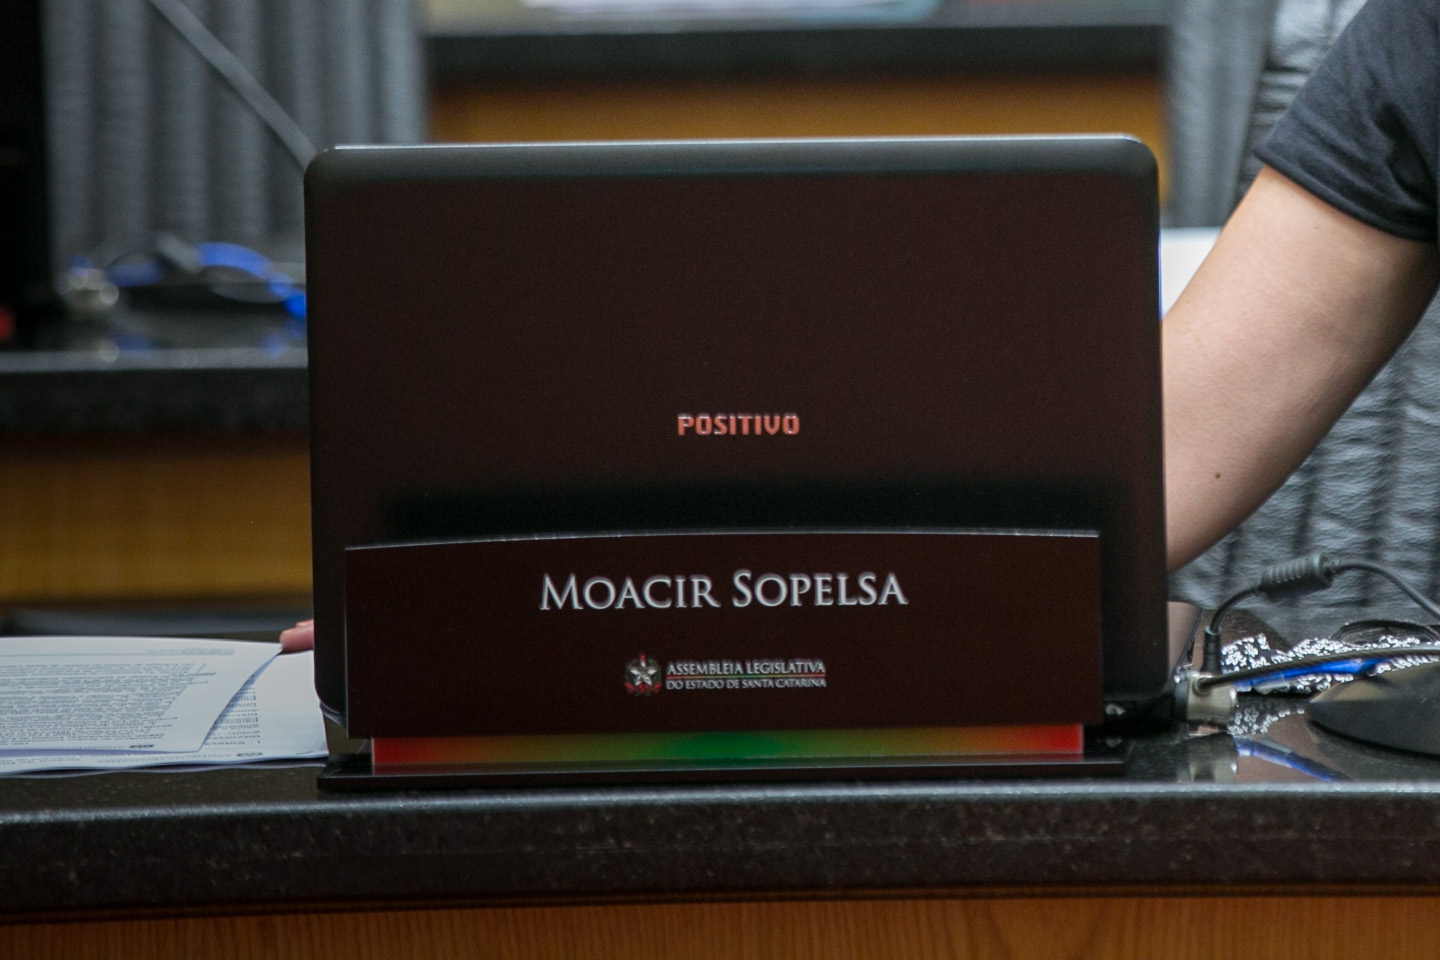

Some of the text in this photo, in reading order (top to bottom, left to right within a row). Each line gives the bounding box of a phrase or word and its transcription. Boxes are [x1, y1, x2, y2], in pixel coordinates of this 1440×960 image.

[677, 413, 800, 436] POSITIVO
[539, 569, 909, 611] MOACIR SOPELSA
[667, 659, 826, 676] ASSEMBLEIA LEGISLATIVA
[666, 677, 827, 690] DO ESTADO DE SANTA CATARINA
